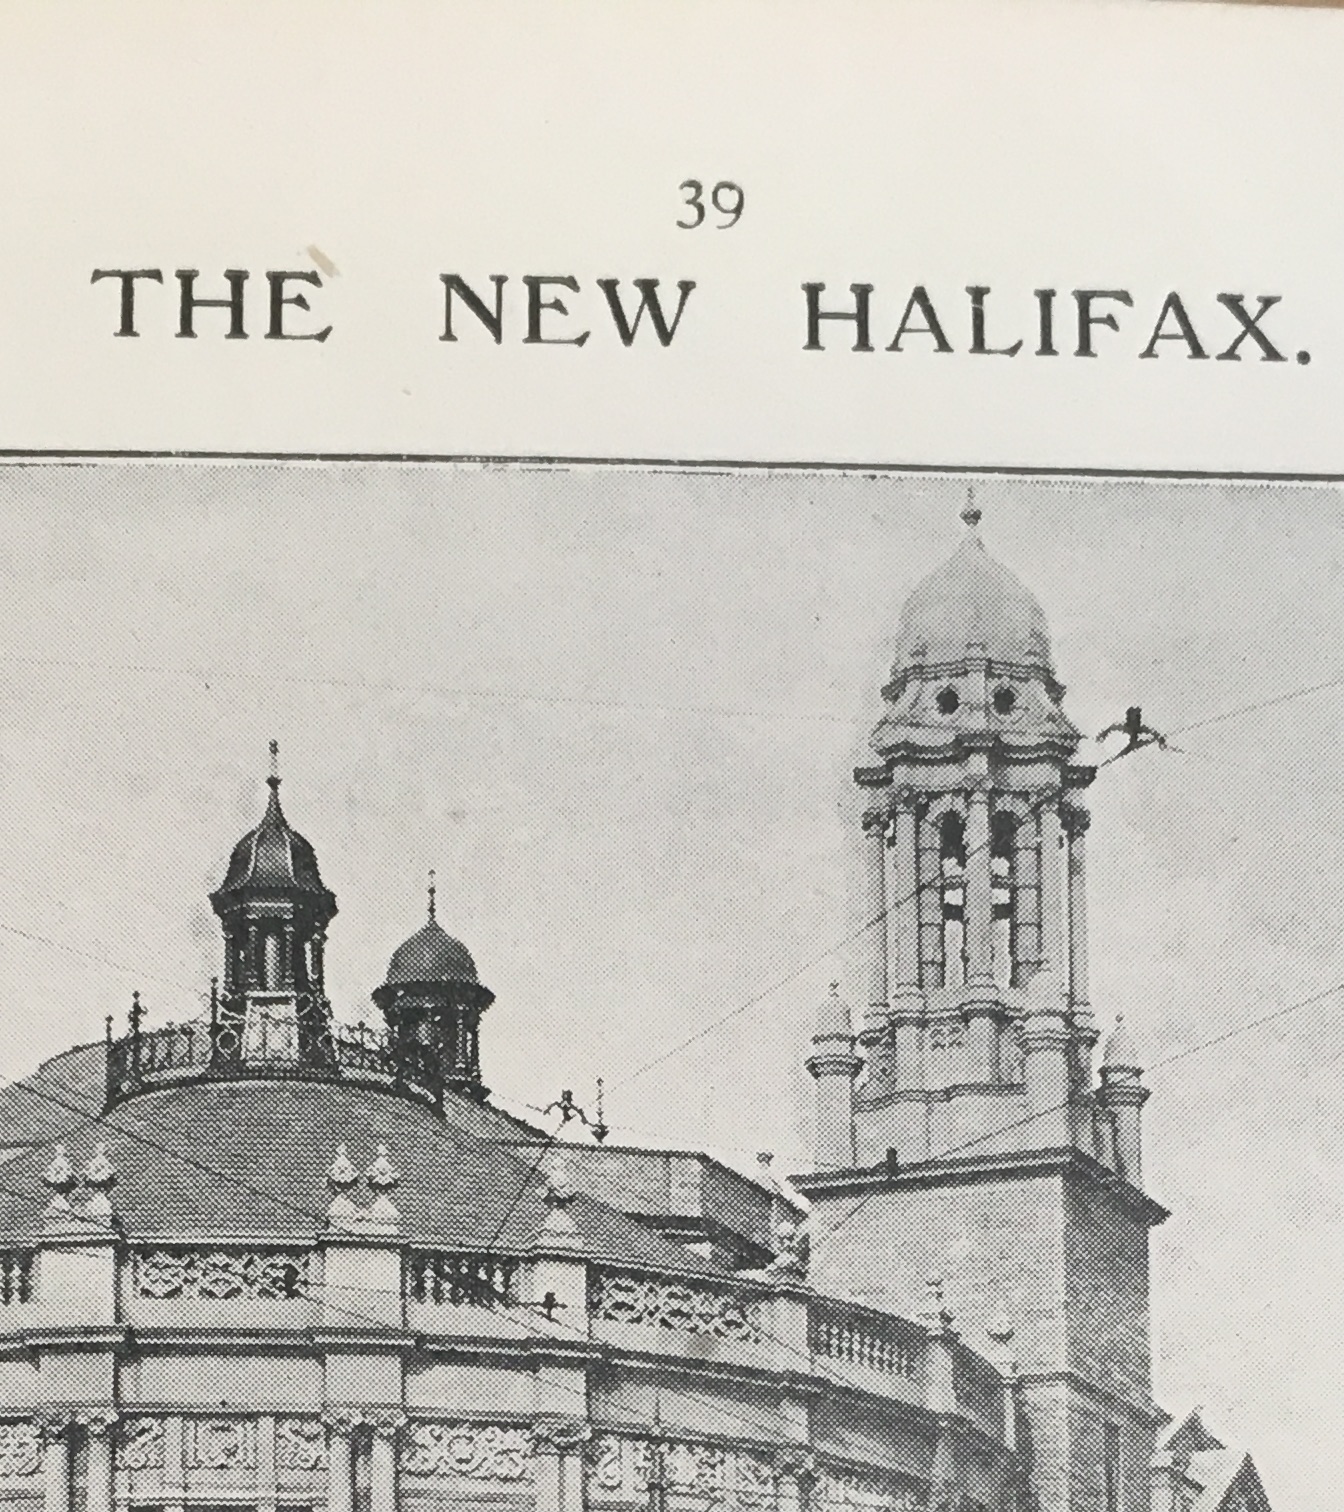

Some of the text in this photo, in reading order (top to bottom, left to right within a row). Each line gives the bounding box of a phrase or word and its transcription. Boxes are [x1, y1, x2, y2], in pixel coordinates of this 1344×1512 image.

[677, 179, 745, 230] 39
[90, 267, 1312, 366] THE NEW HALIFAX.
